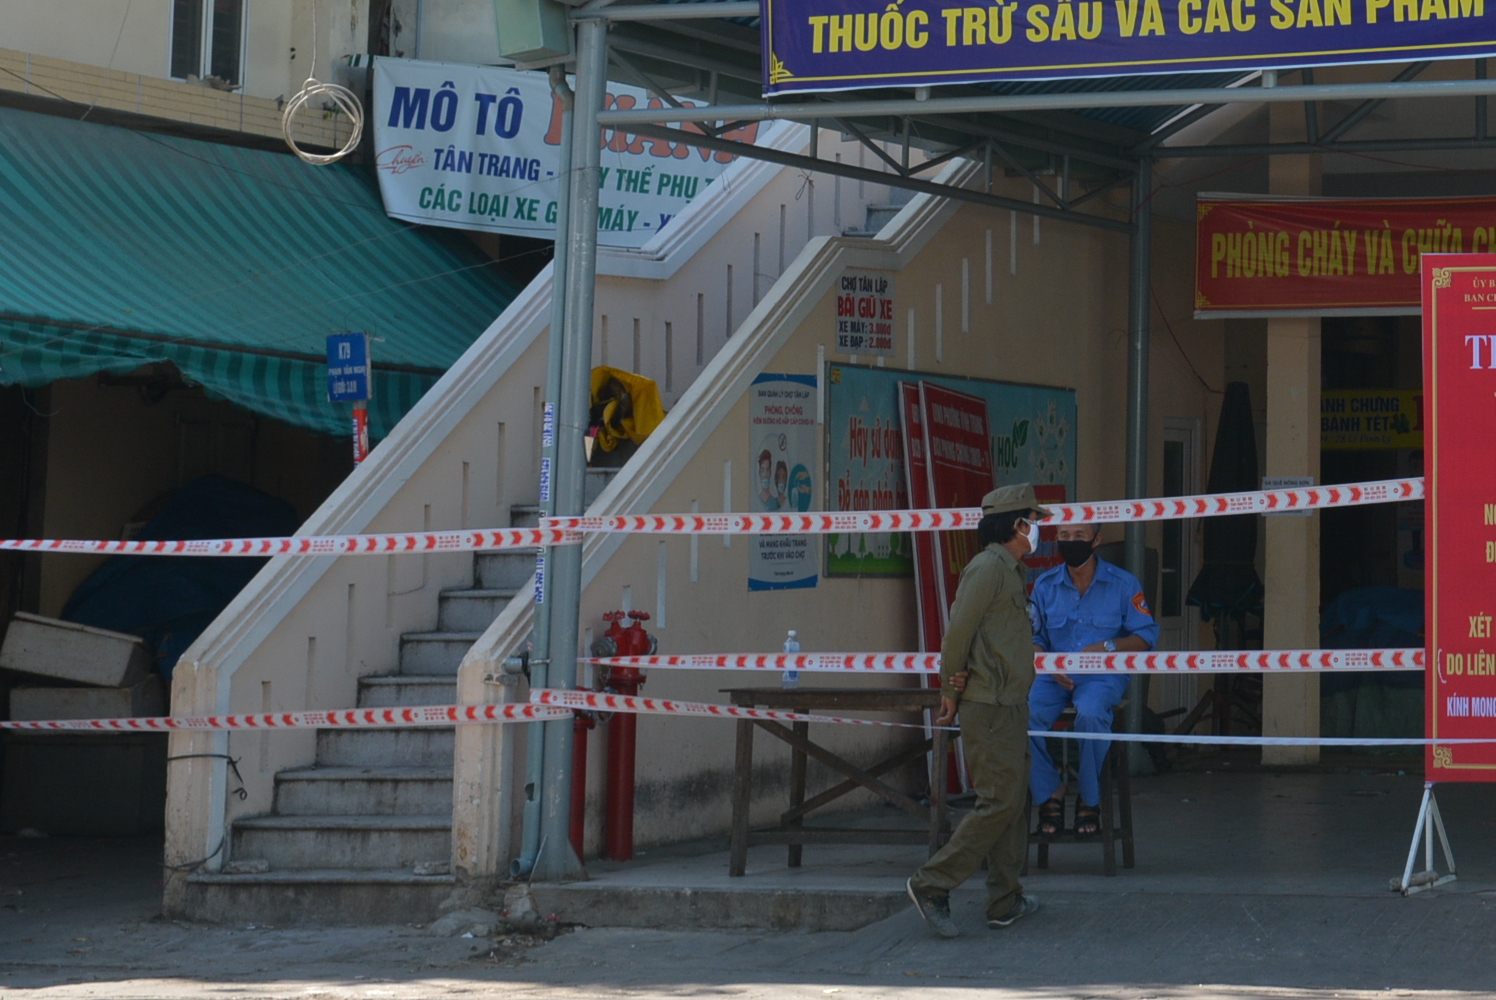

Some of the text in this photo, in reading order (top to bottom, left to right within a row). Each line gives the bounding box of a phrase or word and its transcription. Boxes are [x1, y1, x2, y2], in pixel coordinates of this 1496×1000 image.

[387, 80, 524, 140] MÔ TÔ
[433, 145, 699, 204] TÂN TRANG THẾ PHỤ
[419, 186, 640, 233] CÁC LOẠI XE MÁY
[1210, 221, 1290, 279] PHÒNG
[1297, 221, 1359, 277] CHÁY
[1364, 219, 1395, 275] VÀ
[841, 275, 888, 296] CHỢ TÂN LẬP
[1473, 275, 1488, 288] ỦY
[837, 292, 893, 320] BÃI GIỮ XE
[1464, 292, 1485, 303] BAN
[839, 320, 849, 333] XE
[839, 335, 849, 347] XE
[1351, 396, 1400, 412] CHƯNG
[1321, 413, 1390, 432] BÁNH TẾT
[1468, 611, 1493, 639] XÉT
[1467, 649, 1496, 676] LIÊN
[1446, 692, 1470, 717] KÍNH
